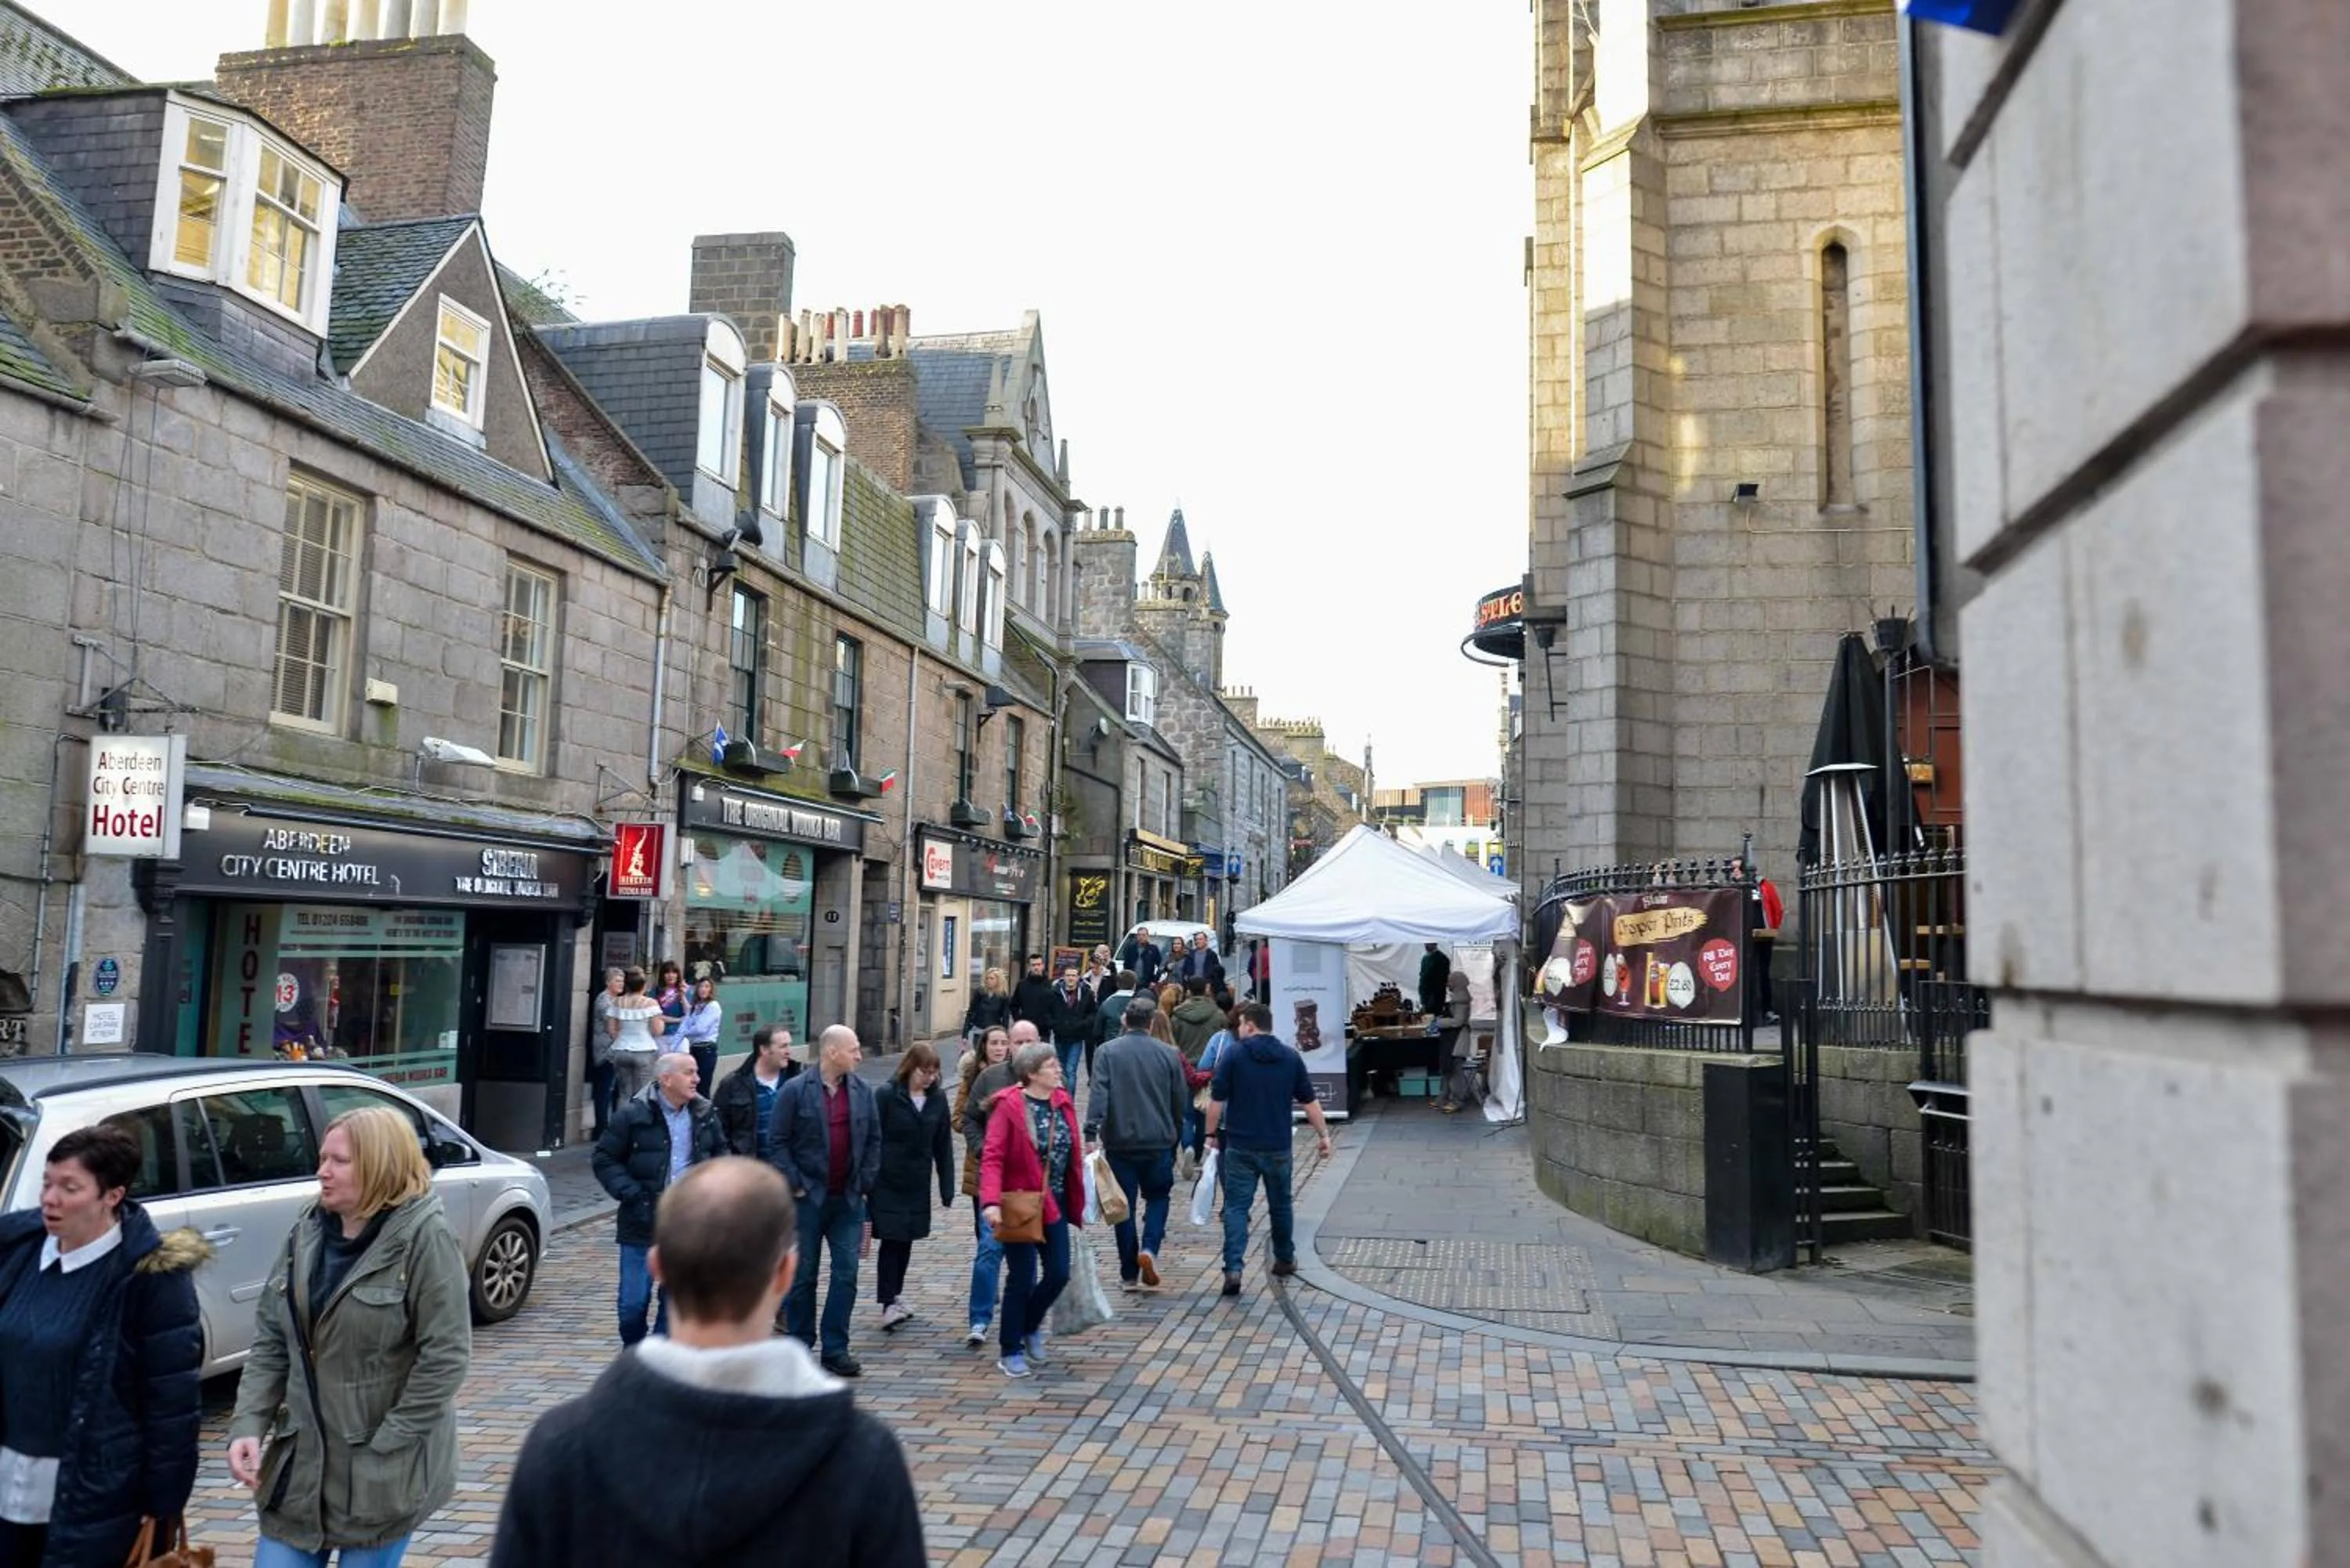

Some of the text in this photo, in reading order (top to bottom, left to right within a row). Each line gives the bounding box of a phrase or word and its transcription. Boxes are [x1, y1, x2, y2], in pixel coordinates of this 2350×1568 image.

[98, 751, 162, 771] Aberdeen
[93, 776, 164, 799] City Centre
[92, 804, 163, 838] Hotel
[722, 797, 743, 825] THE
[823, 817, 841, 842] BAR
[263, 828, 351, 855] ABERDEEN
[222, 854, 381, 885] CITY CENTRE HOTEL
[481, 848, 539, 880] SIBERIA
[1661, 911, 1694, 934] Pints
[238, 913, 262, 1054] HOTE
